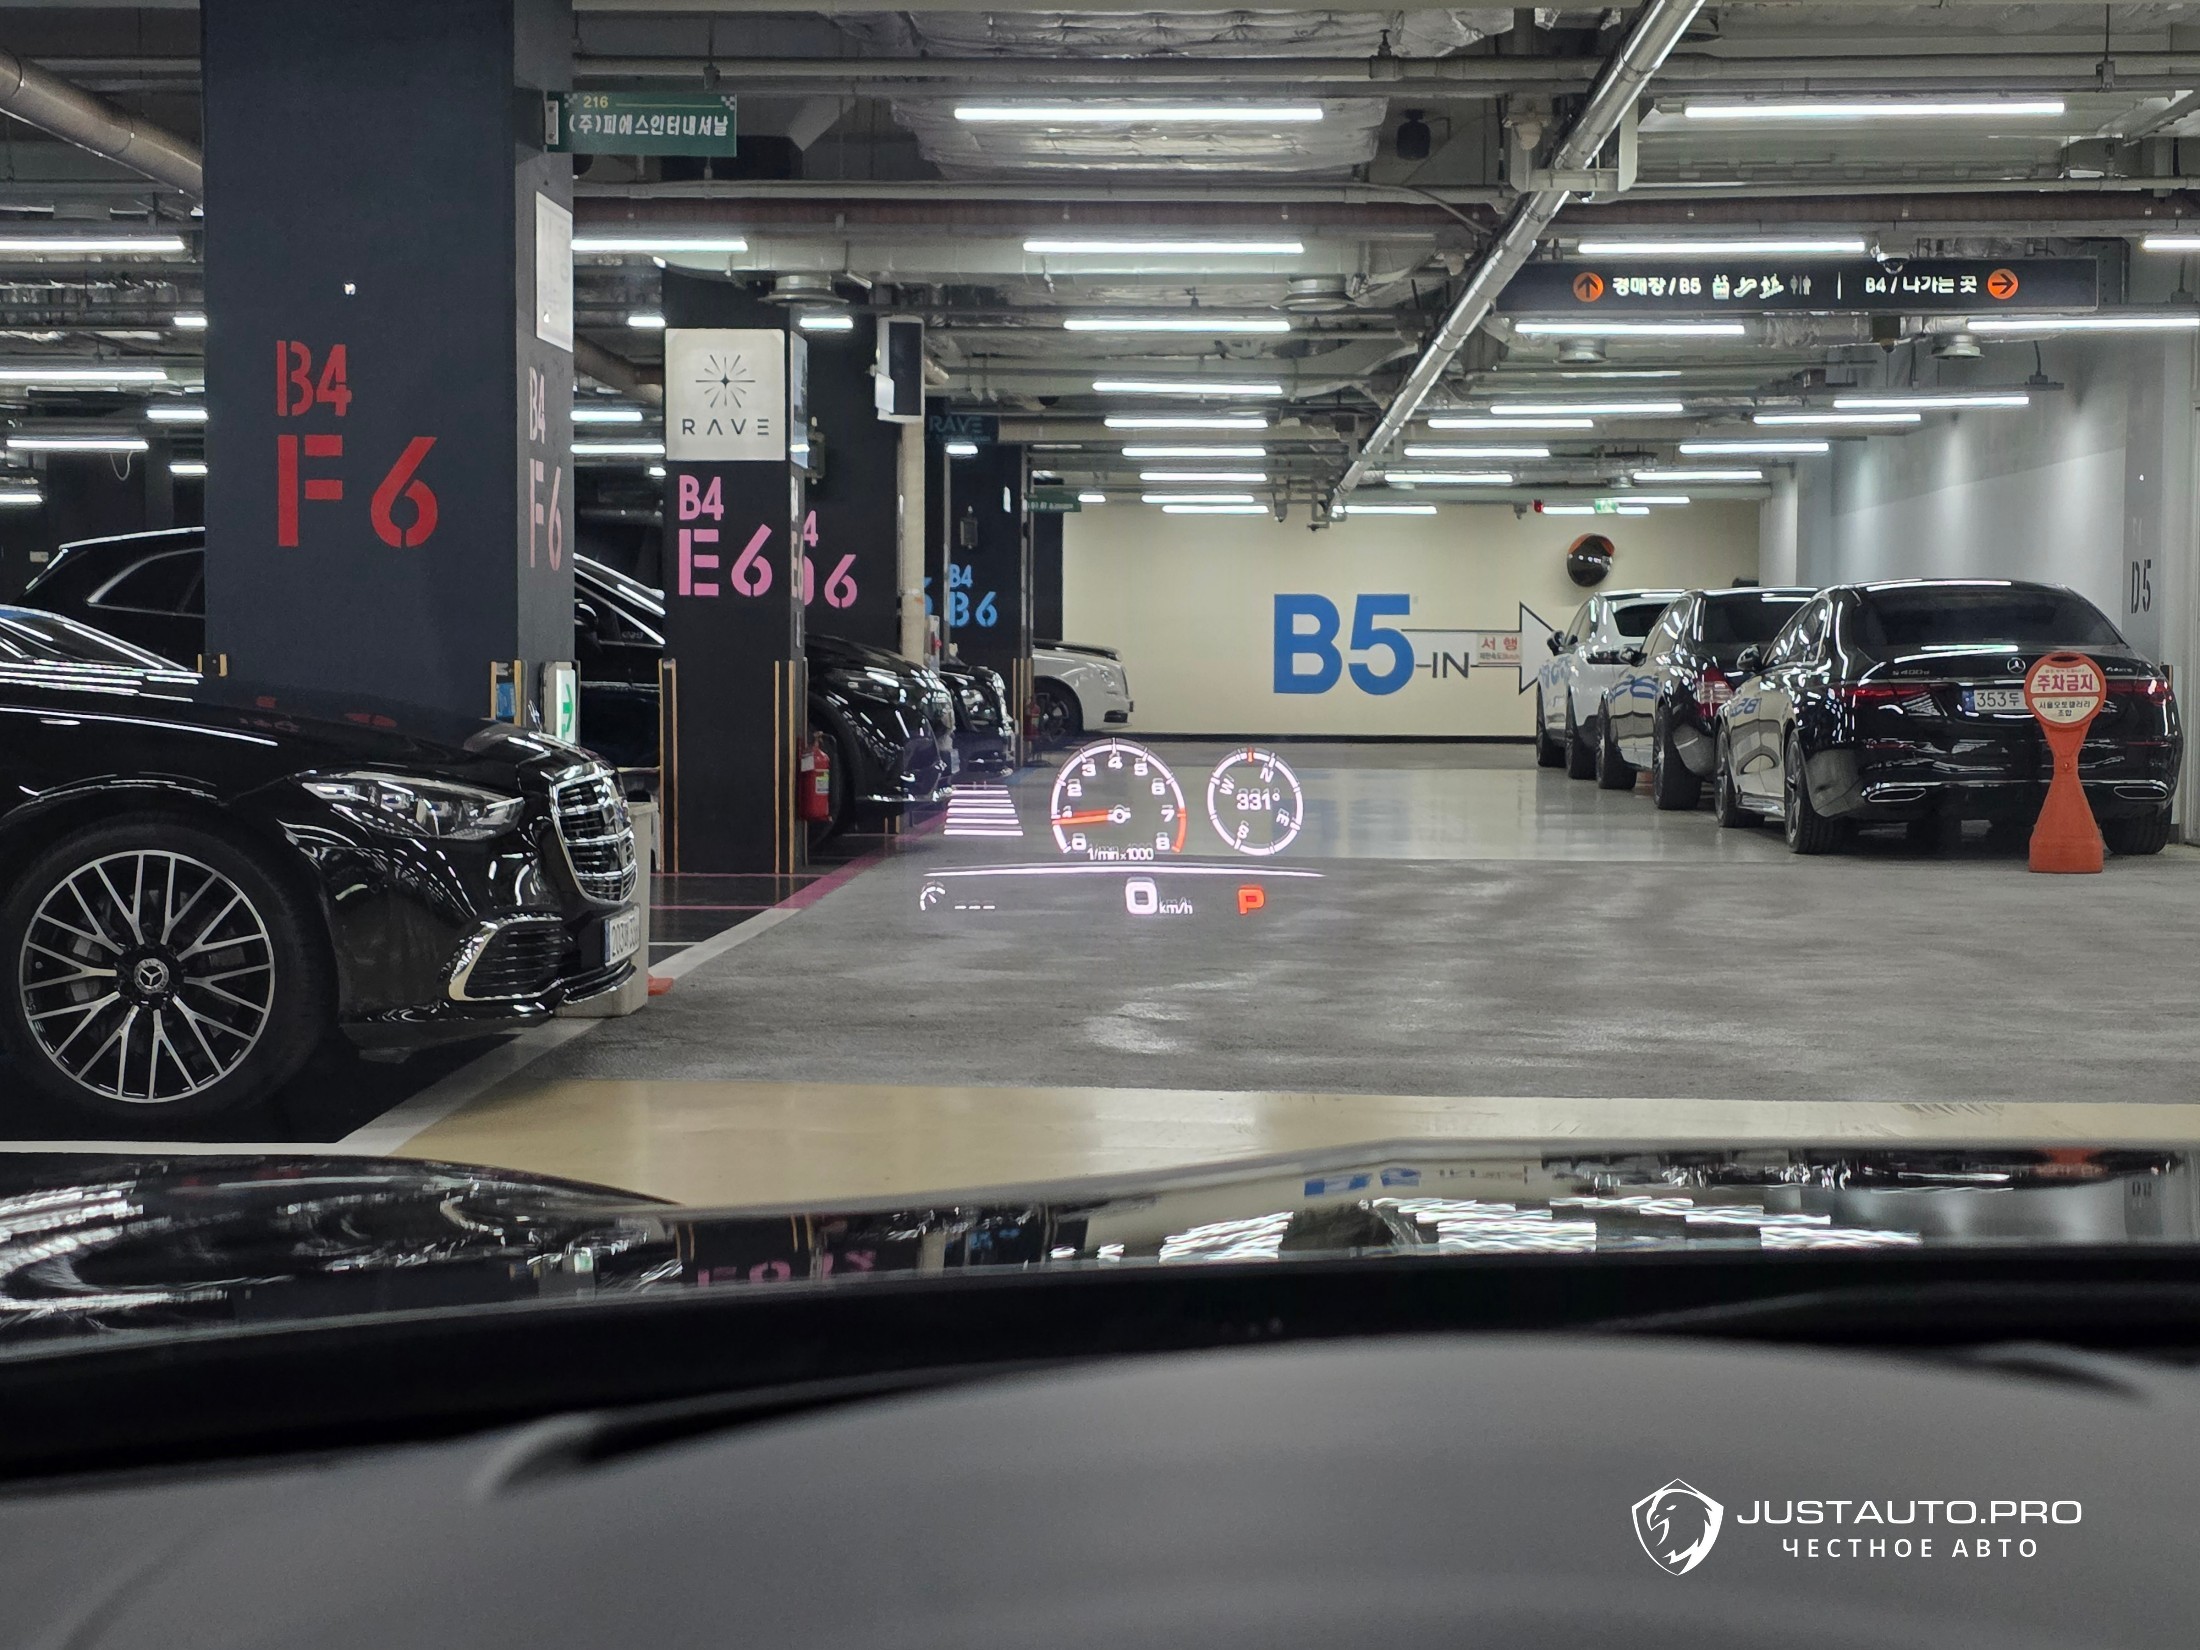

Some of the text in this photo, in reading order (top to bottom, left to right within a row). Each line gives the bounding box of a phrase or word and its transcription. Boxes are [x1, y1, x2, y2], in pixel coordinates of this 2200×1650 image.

[583, 95, 608, 108] 216
[1903, 275, 1955, 294] 나가는
[1959, 275, 1978, 294] 곳
[276, 340, 352, 417] B4
[529, 366, 546, 444] B4
[682, 418, 770, 436] RAVE
[679, 475, 724, 521] B4
[679, 523, 773, 597] E6
[949, 564, 973, 588] B4
[2130, 559, 2152, 614] D5
[949, 591, 998, 627] B6
[1273, 594, 1470, 695] B5 IN
[2037, 673, 2093, 691] 주차금지
[1082, 761, 1096, 776] 3
[1108, 755, 1123, 769] 4
[1134, 761, 1148, 776] 5
[1260, 766, 1274, 783] N
[1067, 781, 1082, 797] 2
[1152, 781, 1165, 796] 6
[1220, 777, 1234, 795] W
[1161, 808, 1175, 822] 7
[1276, 811, 1289, 827] E
[1072, 837, 1086, 851] 0
[1156, 836, 1170, 850] 8
[1125, 880, 1194, 915] 0 km/h
[1238, 887, 1265, 915] P
